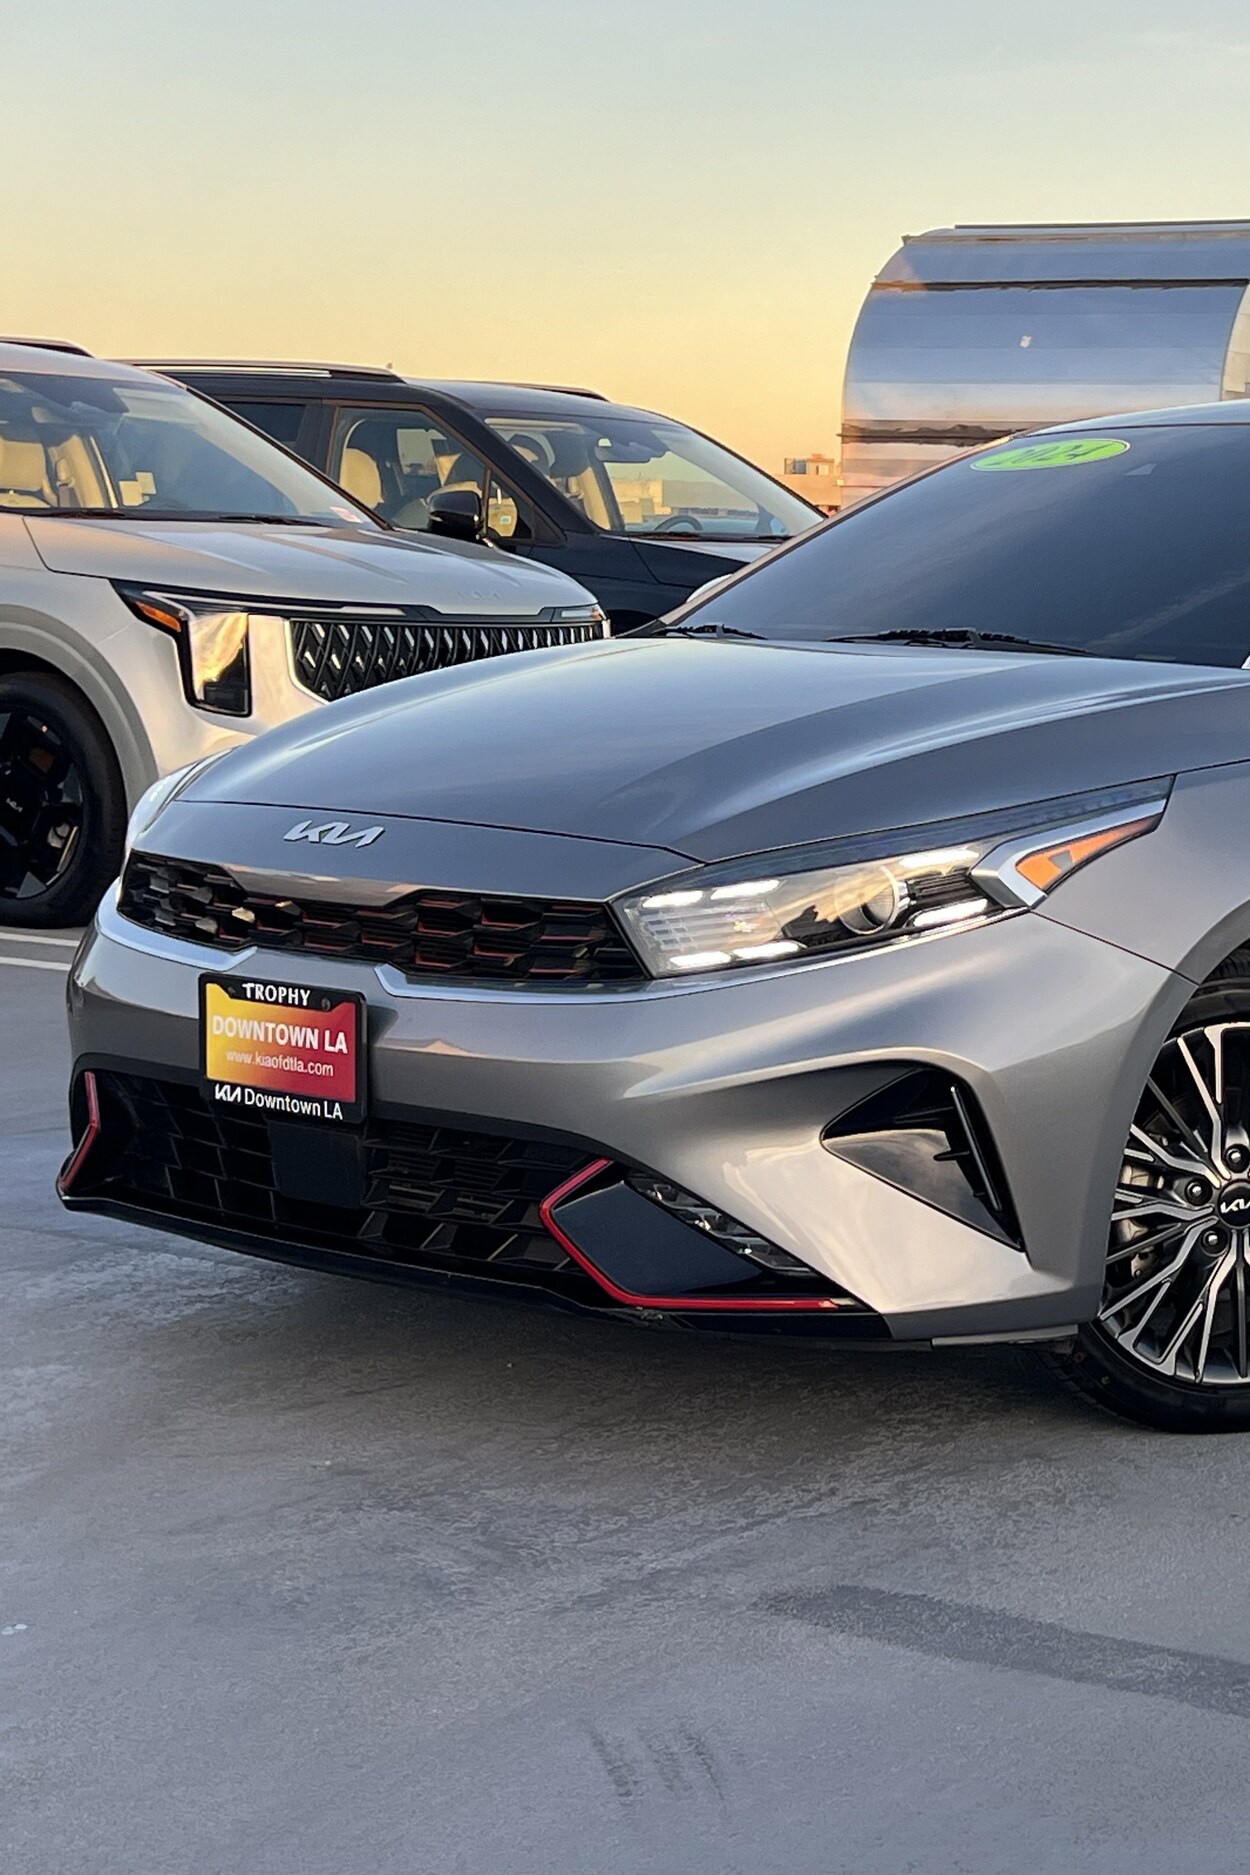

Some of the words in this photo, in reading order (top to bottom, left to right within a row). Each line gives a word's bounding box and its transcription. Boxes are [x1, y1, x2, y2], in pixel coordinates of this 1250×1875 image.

[283, 819, 385, 848] KIA
[242, 983, 311, 1006] TROPHY
[212, 1015, 319, 1050] DOWNTOWN
[324, 1030, 348, 1054] LA
[226, 1051, 334, 1077] www.kiaofdtla.com
[214, 1083, 241, 1103] KIA
[244, 1088, 321, 1117] Downtown
[324, 1101, 343, 1120] LA
